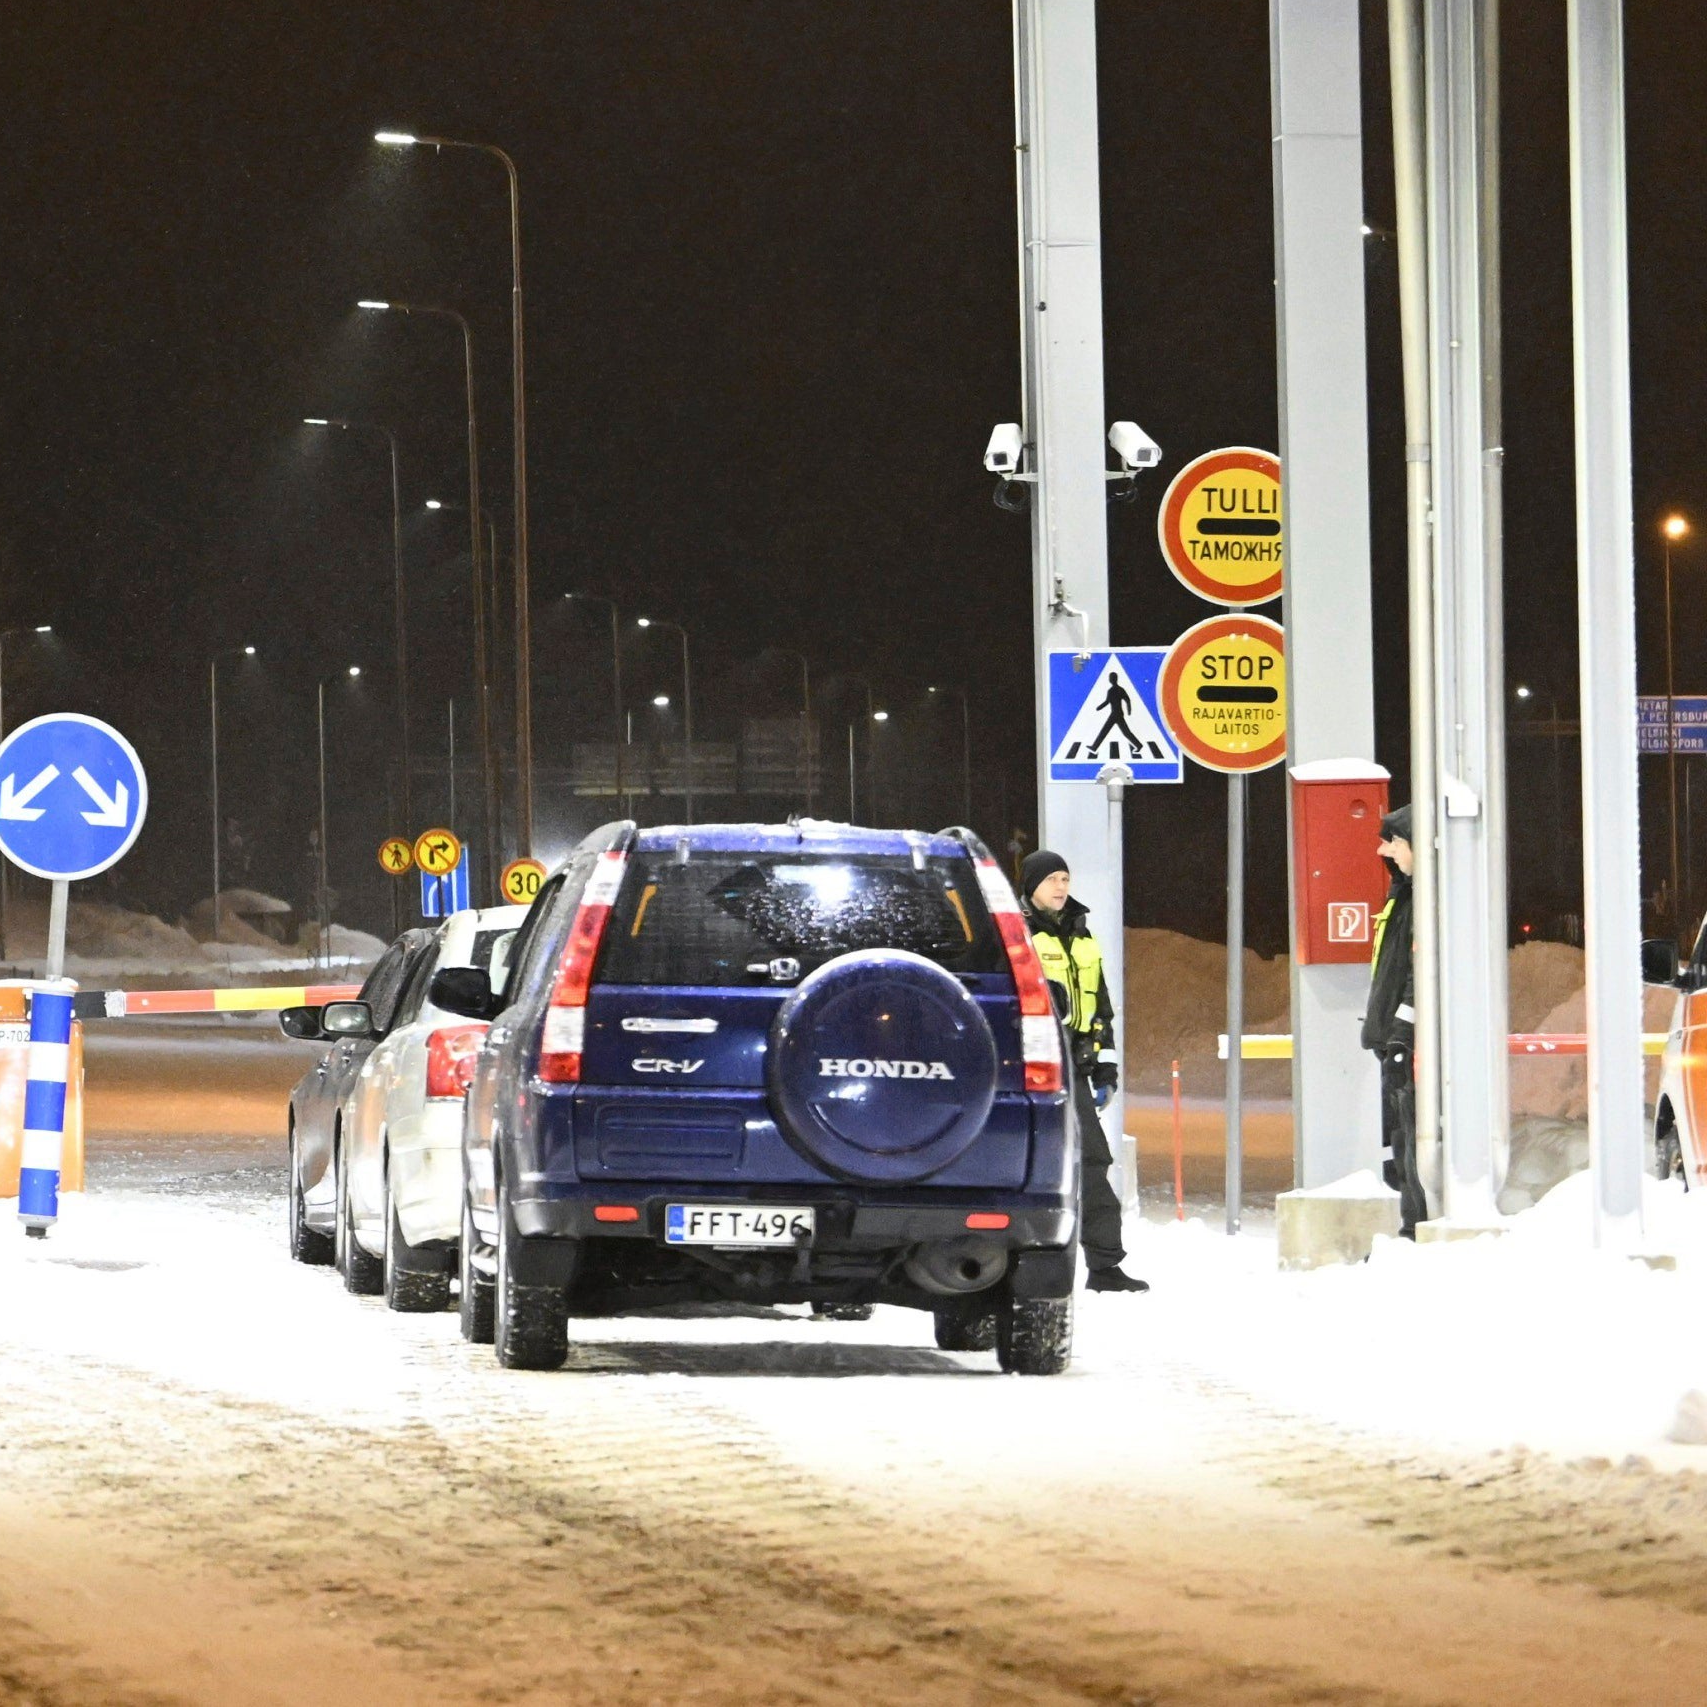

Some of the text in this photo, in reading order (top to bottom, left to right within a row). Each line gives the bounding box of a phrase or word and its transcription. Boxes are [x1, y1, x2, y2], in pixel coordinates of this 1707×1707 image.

[1201, 487, 1278, 514] TULLI
[1200, 655, 1275, 681] STOP
[1192, 707, 1282, 722] RAJAVARTIO-
[1214, 722, 1260, 736] LAITOS
[510, 872, 540, 895] 30
[631, 1057, 705, 1074] CR-V
[819, 1058, 956, 1081] HONDA
[689, 1212, 806, 1237] FFT-496
